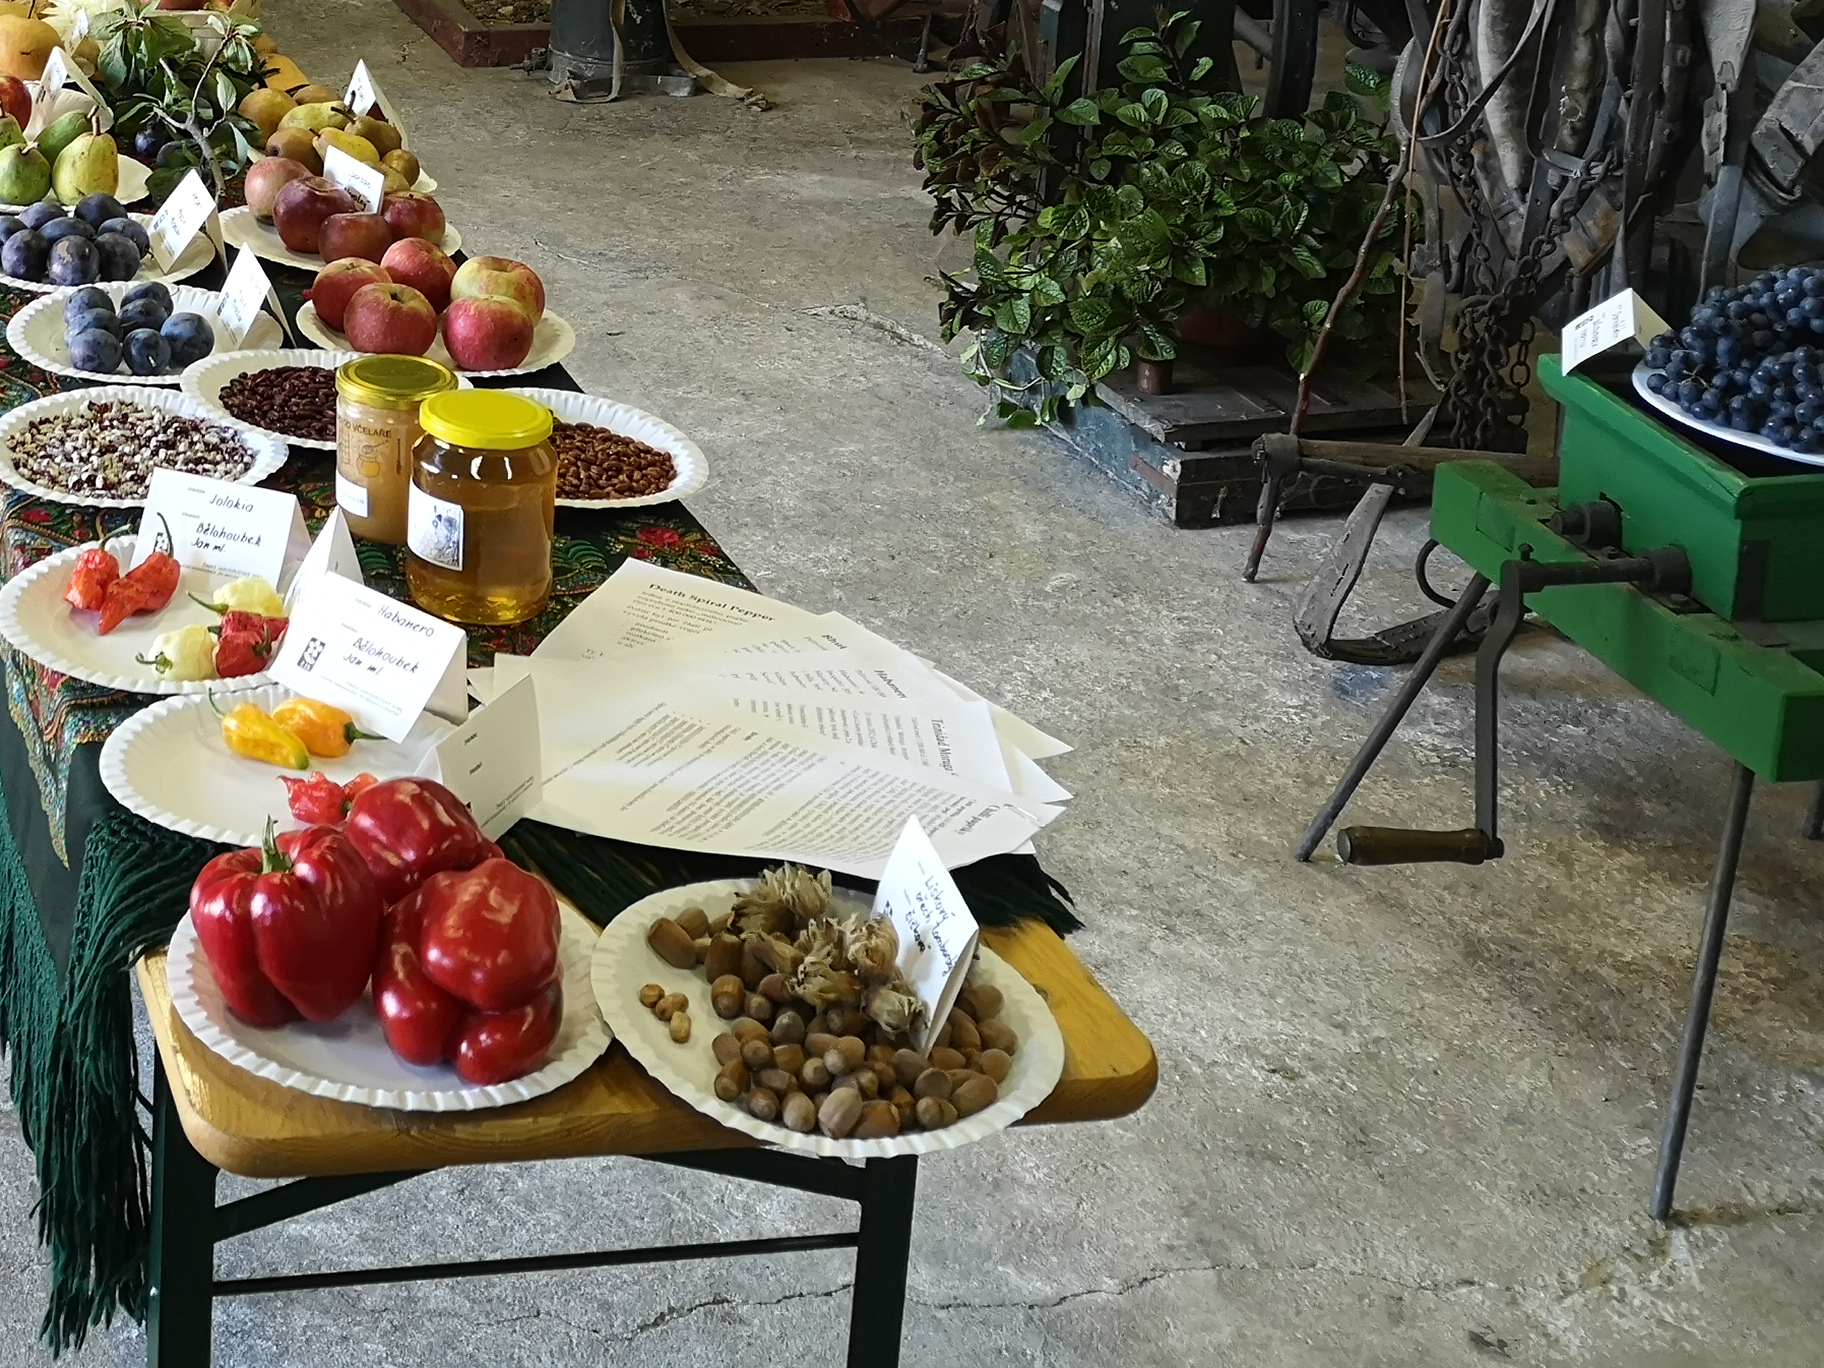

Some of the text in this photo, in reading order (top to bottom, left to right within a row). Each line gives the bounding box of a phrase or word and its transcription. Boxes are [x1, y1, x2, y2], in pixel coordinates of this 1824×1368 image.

[209, 493, 254, 513] Jolokia
[190, 537, 210, 549] Jan
[195, 522, 262, 547] Bělohoubek
[648, 583, 776, 622] Death Spiral Pepper
[377, 604, 435, 638] Habanero
[342, 652, 363, 667] Jan
[352, 637, 420, 674] Bělohoubek
